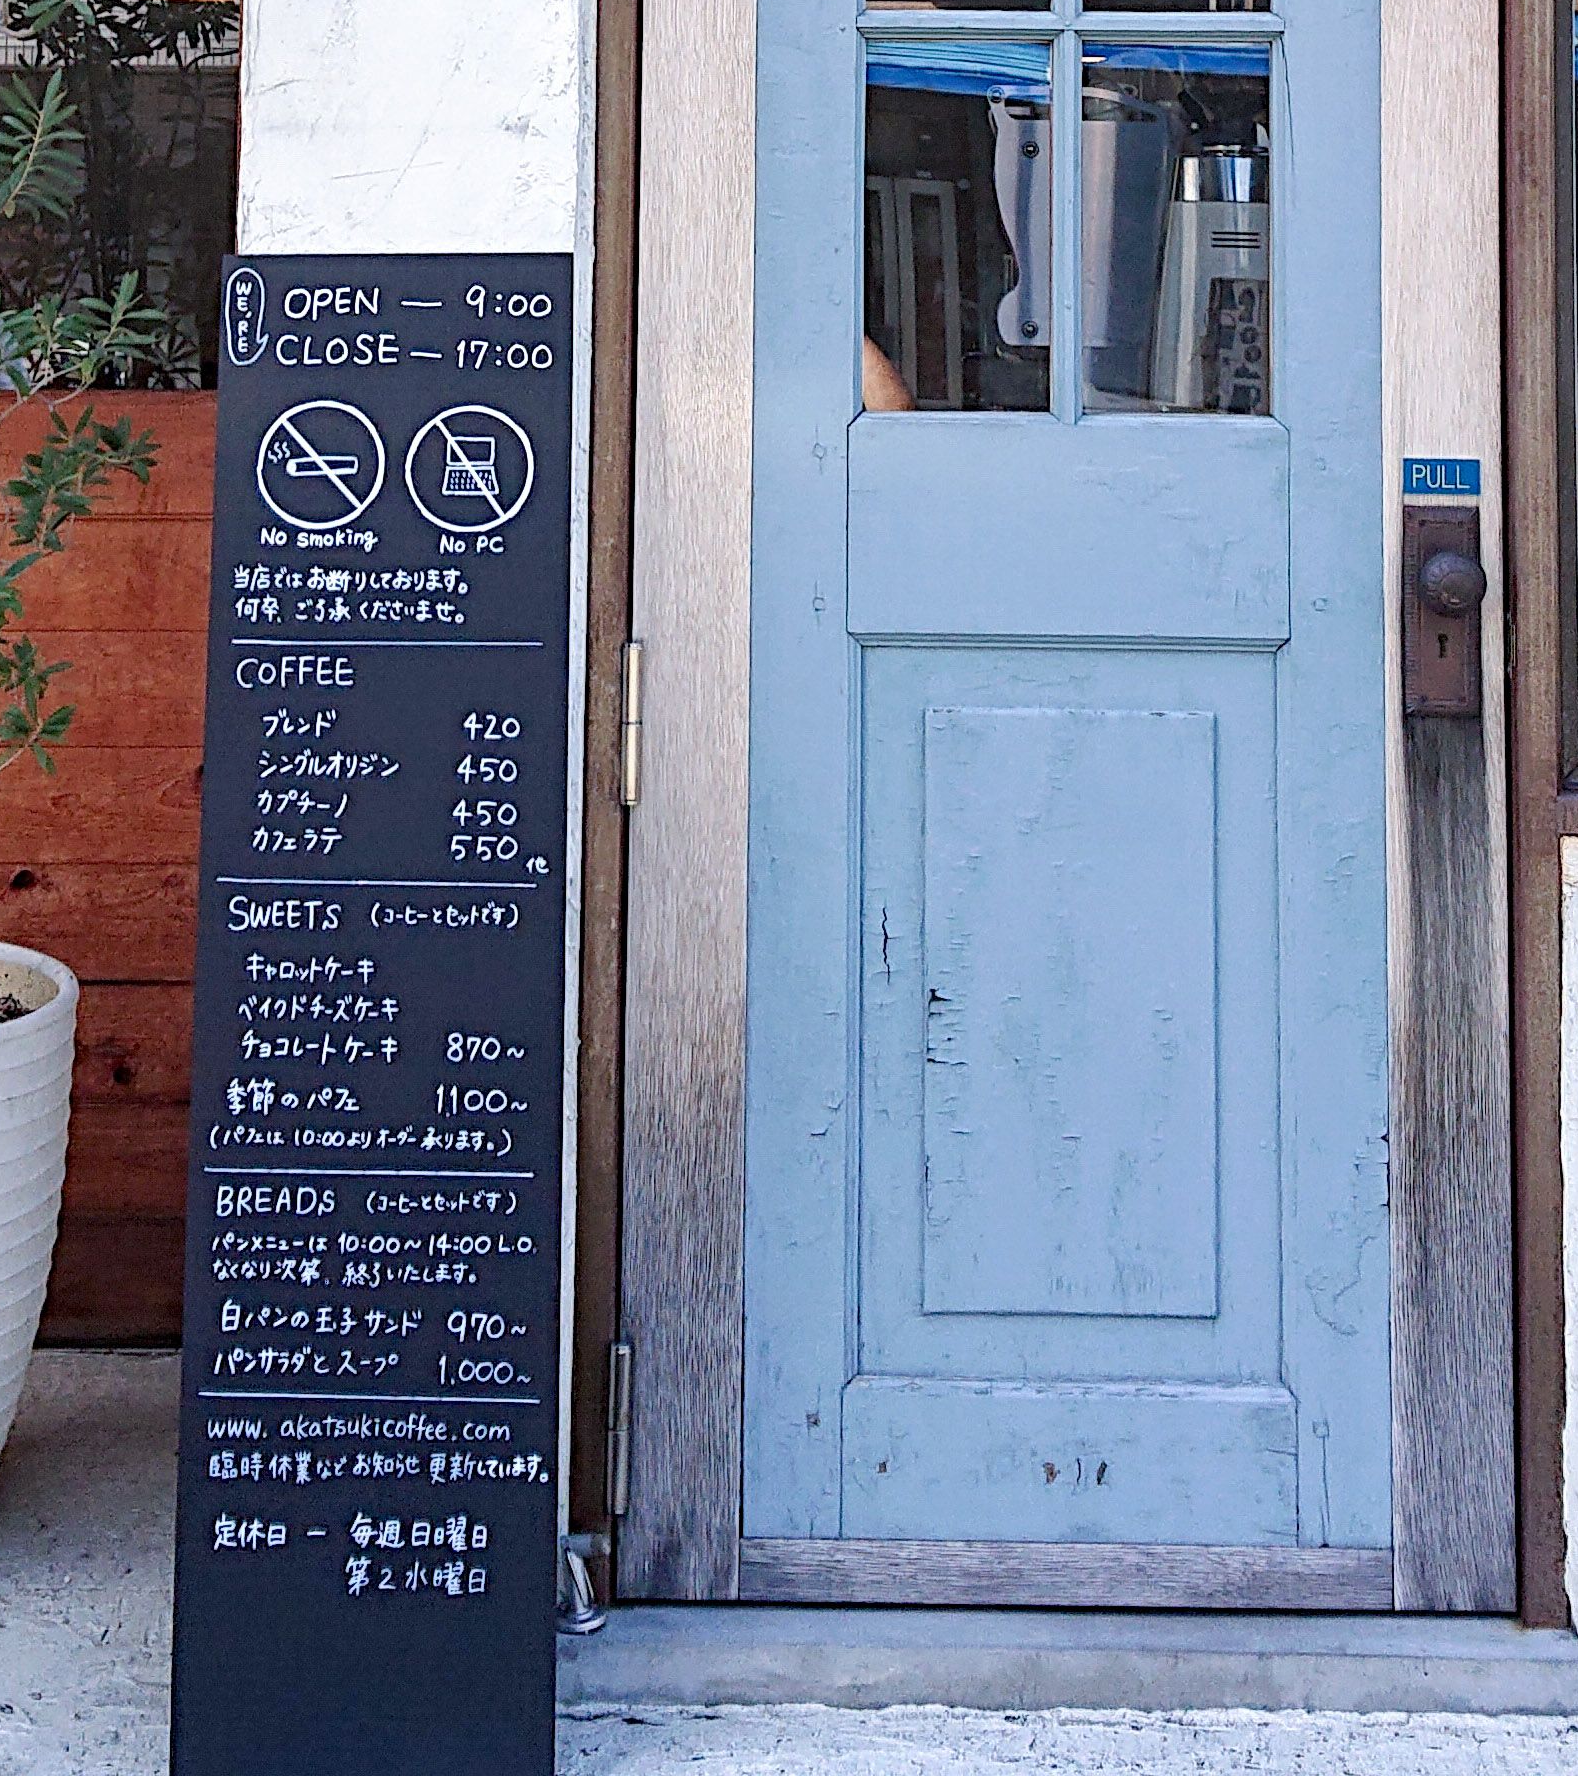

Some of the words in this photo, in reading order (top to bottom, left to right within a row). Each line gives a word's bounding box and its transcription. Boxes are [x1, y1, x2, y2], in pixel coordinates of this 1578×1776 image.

[284, 286, 380, 322] OPEN
[465, 284, 552, 318] 9:00
[275, 333, 400, 366] CLOSE
[456, 339, 553, 370] 17:00
[1411, 464, 1471, 489] PULL
[260, 526, 288, 547] No
[296, 528, 379, 553] smoking
[439, 535, 466, 555] No
[476, 535, 505, 554] PC
[233, 564, 469, 597] 当店ではお断りしております。
[262, 707, 337, 738] ブレンド
[463, 712, 521, 741] 420
[258, 748, 400, 779] シングルオリジン
[456, 754, 518, 785] 450
[257, 789, 348, 819] カプチーノ
[452, 798, 518, 827] 450
[252, 826, 343, 855] カフェラテ
[450, 835, 519, 861] 550
[227, 895, 342, 931] SWEETS
[246, 952, 375, 985] キャロットケーキ
[238, 994, 399, 1022] ベイクドチーズケーキ
[241, 1029, 398, 1066] チョコレートケーキ
[226, 1077, 360, 1116] 季節のパフェ
[216, 1185, 335, 1217] BREADS
[221, 1298, 422, 1337] 白パンの玉子サンド
[213, 1346, 399, 1376] パンサラダとスープ
[213, 1512, 287, 1551] 定休日
[349, 1511, 488, 1552] 毎週日曜日
[345, 1555, 486, 1596] 第2水曜日
